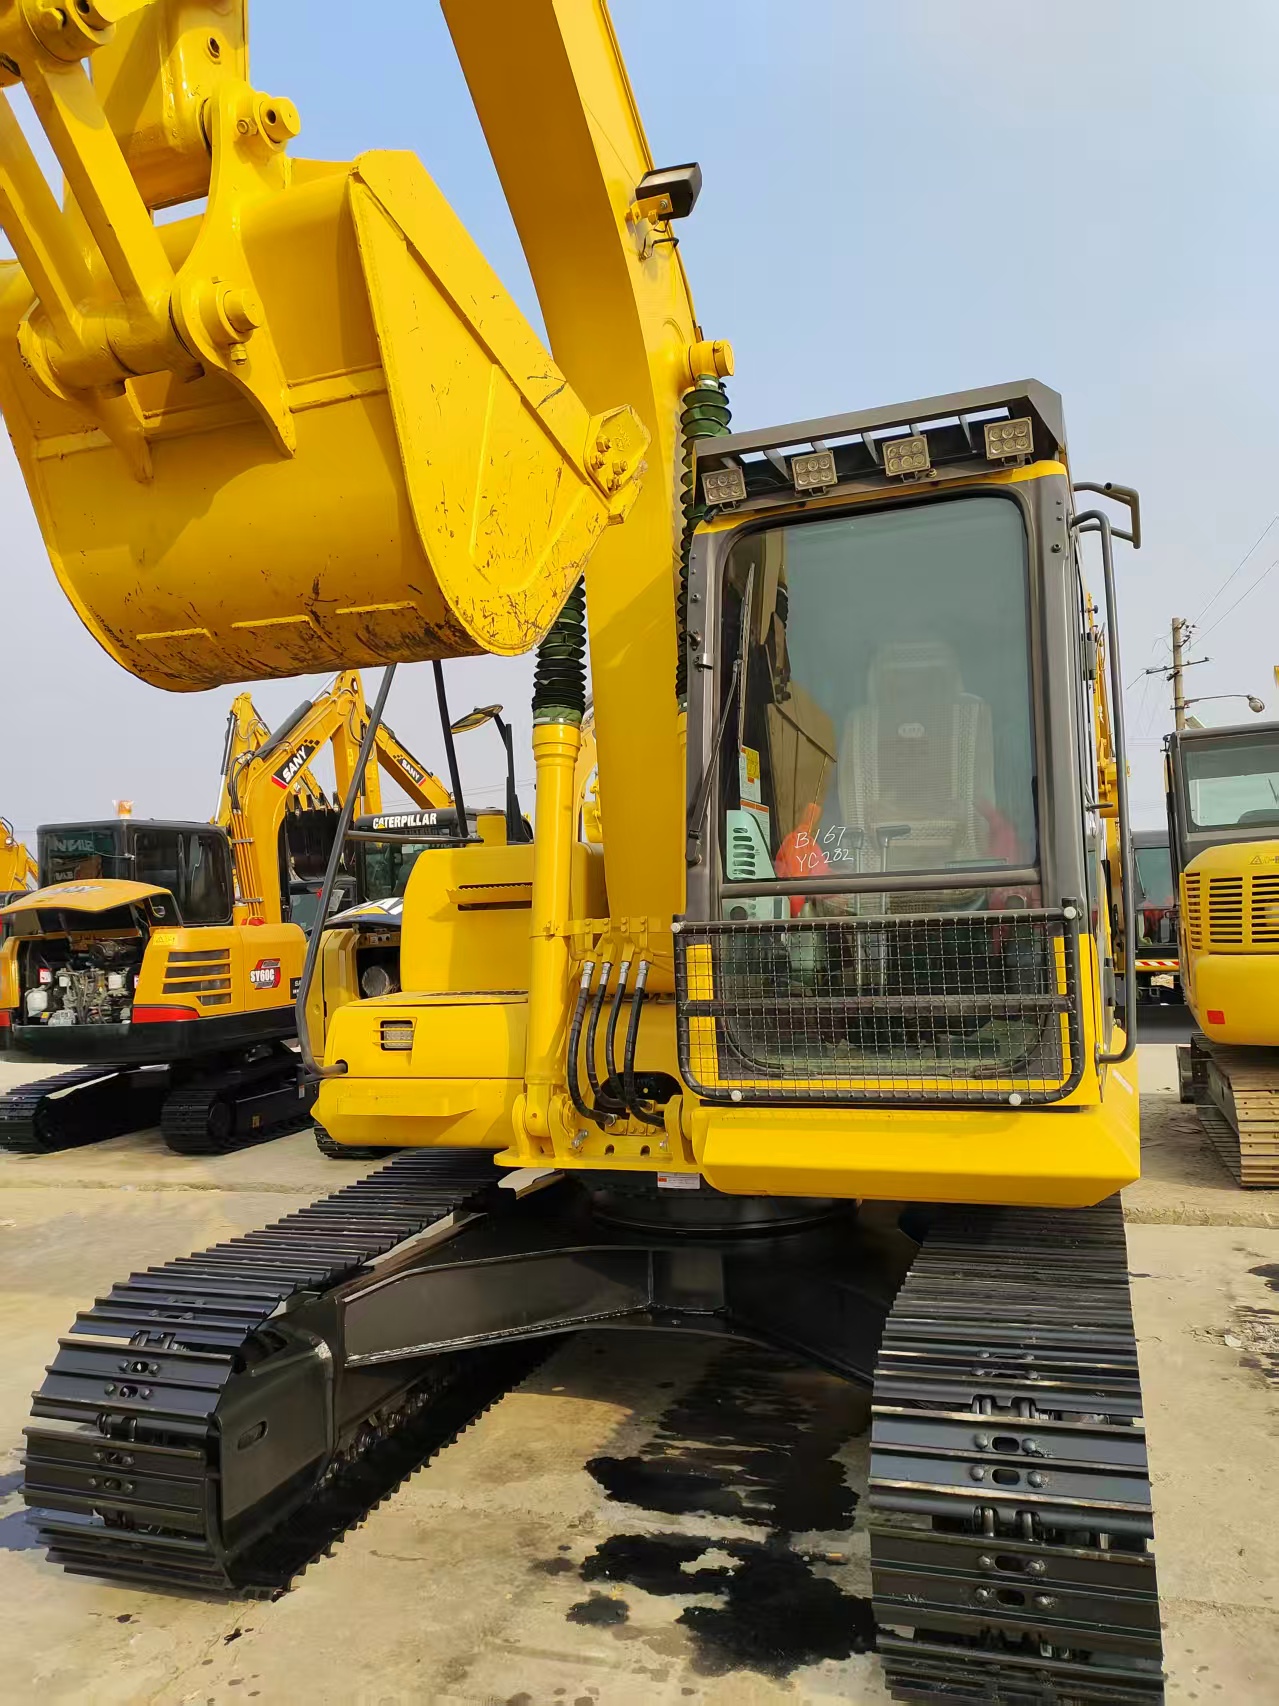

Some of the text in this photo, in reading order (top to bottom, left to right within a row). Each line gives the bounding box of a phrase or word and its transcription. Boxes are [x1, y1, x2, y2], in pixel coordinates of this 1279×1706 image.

[282, 745, 307, 783] SANY
[401, 759, 420, 781] SANY
[372, 812, 437, 830] CATERPILLAR
[795, 847, 855, 873] YC282
[250, 968, 275, 983] SY60C
